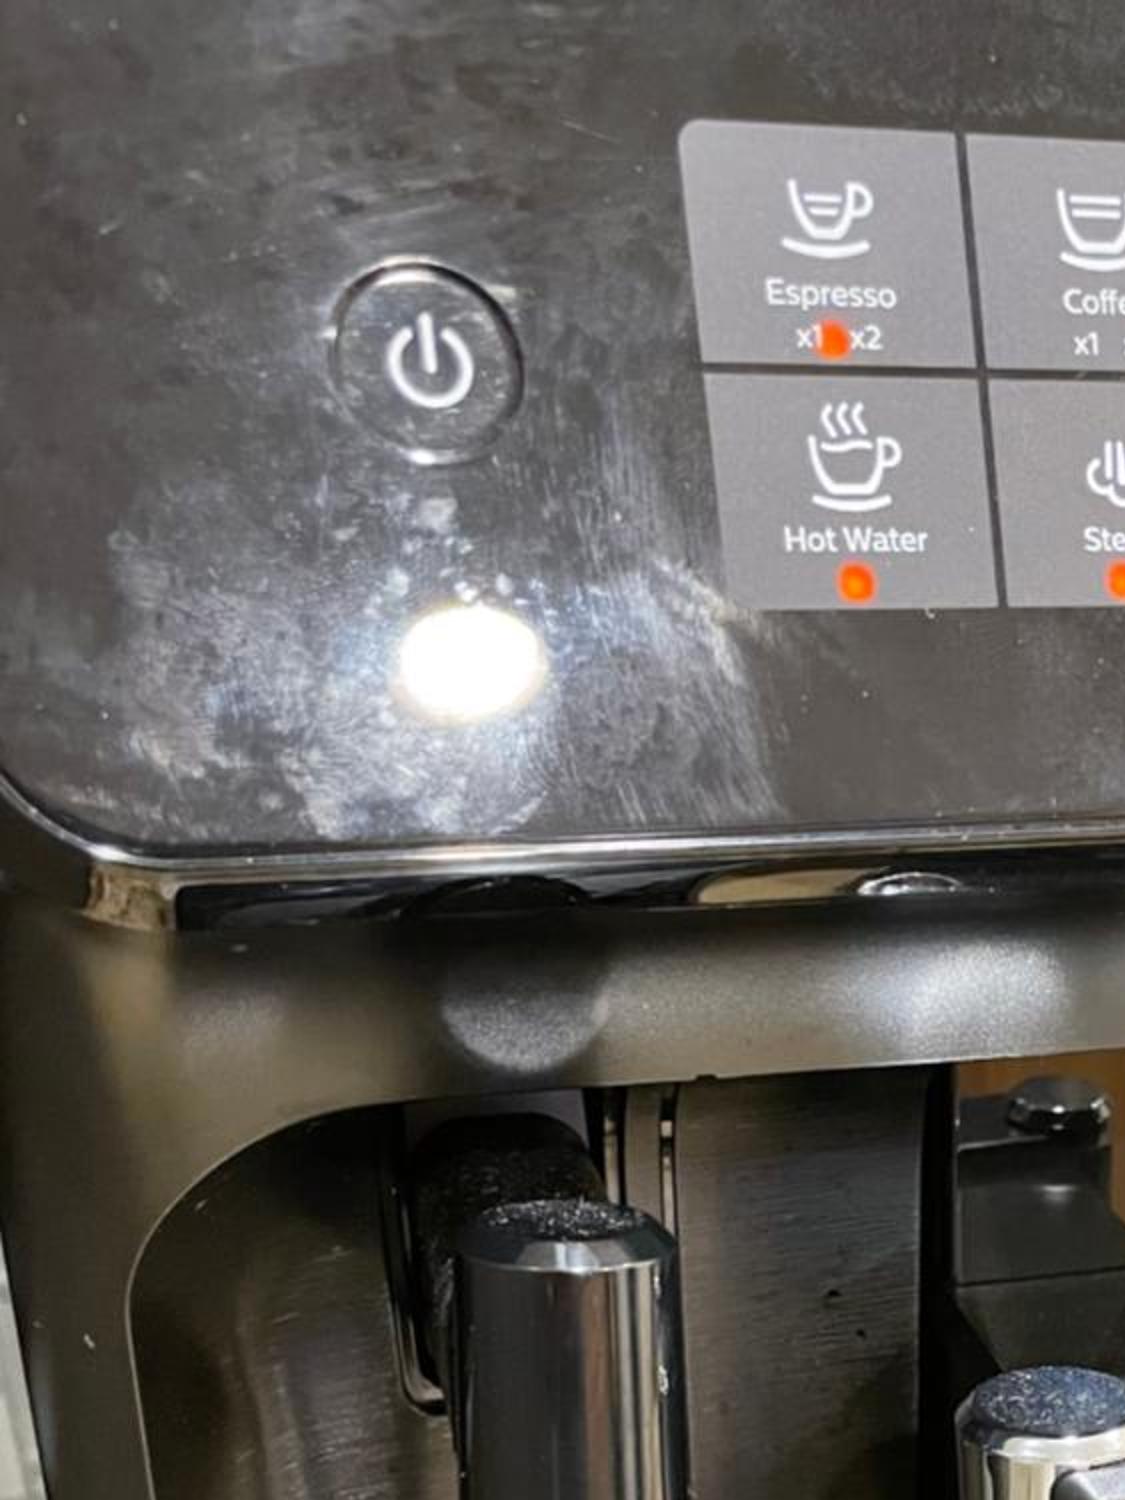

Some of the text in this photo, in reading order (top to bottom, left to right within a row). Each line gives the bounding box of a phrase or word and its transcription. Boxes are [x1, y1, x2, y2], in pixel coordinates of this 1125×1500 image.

[765, 276, 898, 312] Espresso
[796, 323, 884, 351] x1 x2
[1073, 333, 1100, 357] x1
[783, 525, 928, 554] Hot Water
